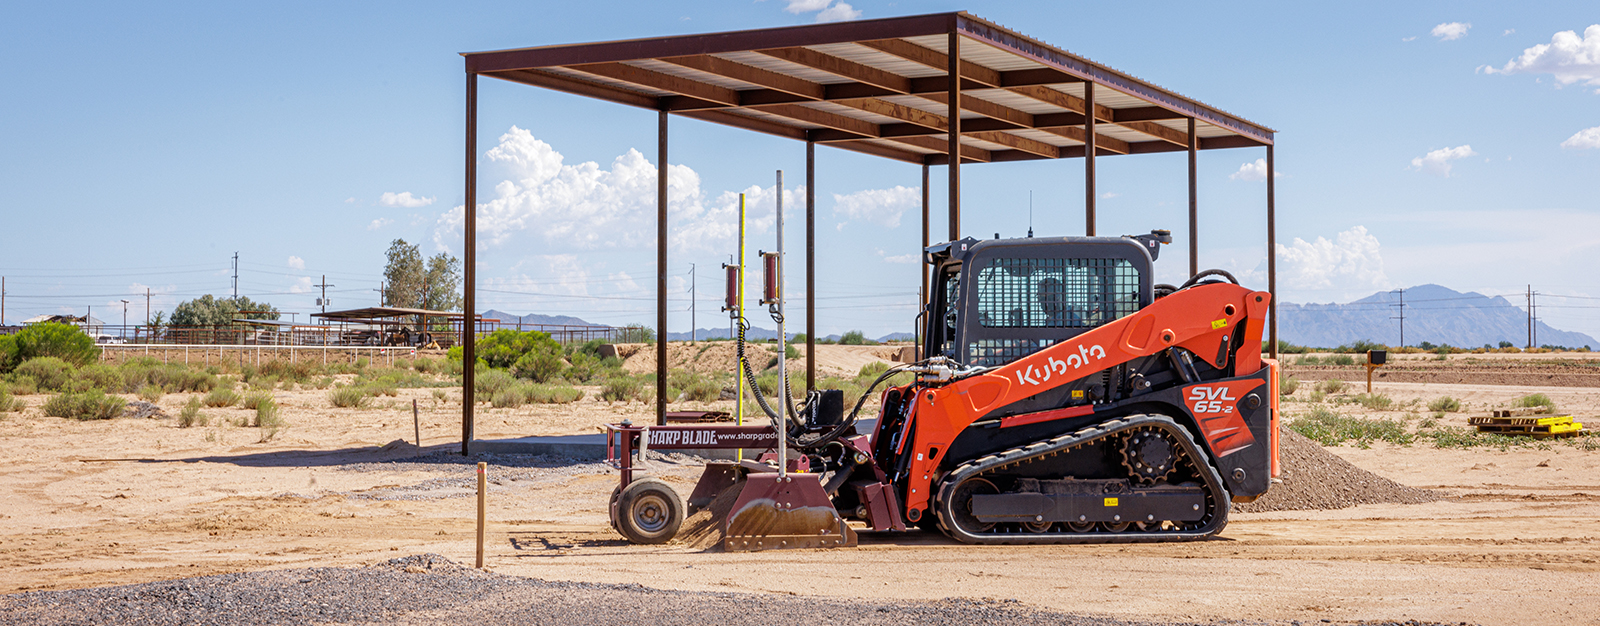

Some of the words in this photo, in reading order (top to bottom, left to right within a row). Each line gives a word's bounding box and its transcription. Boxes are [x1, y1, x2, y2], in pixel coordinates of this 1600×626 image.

[1016, 344, 1107, 386] Kubota
[1188, 387, 1236, 401] SVL
[1193, 401, 1234, 413] 65-2
[681, 430, 718, 445] BLADE
